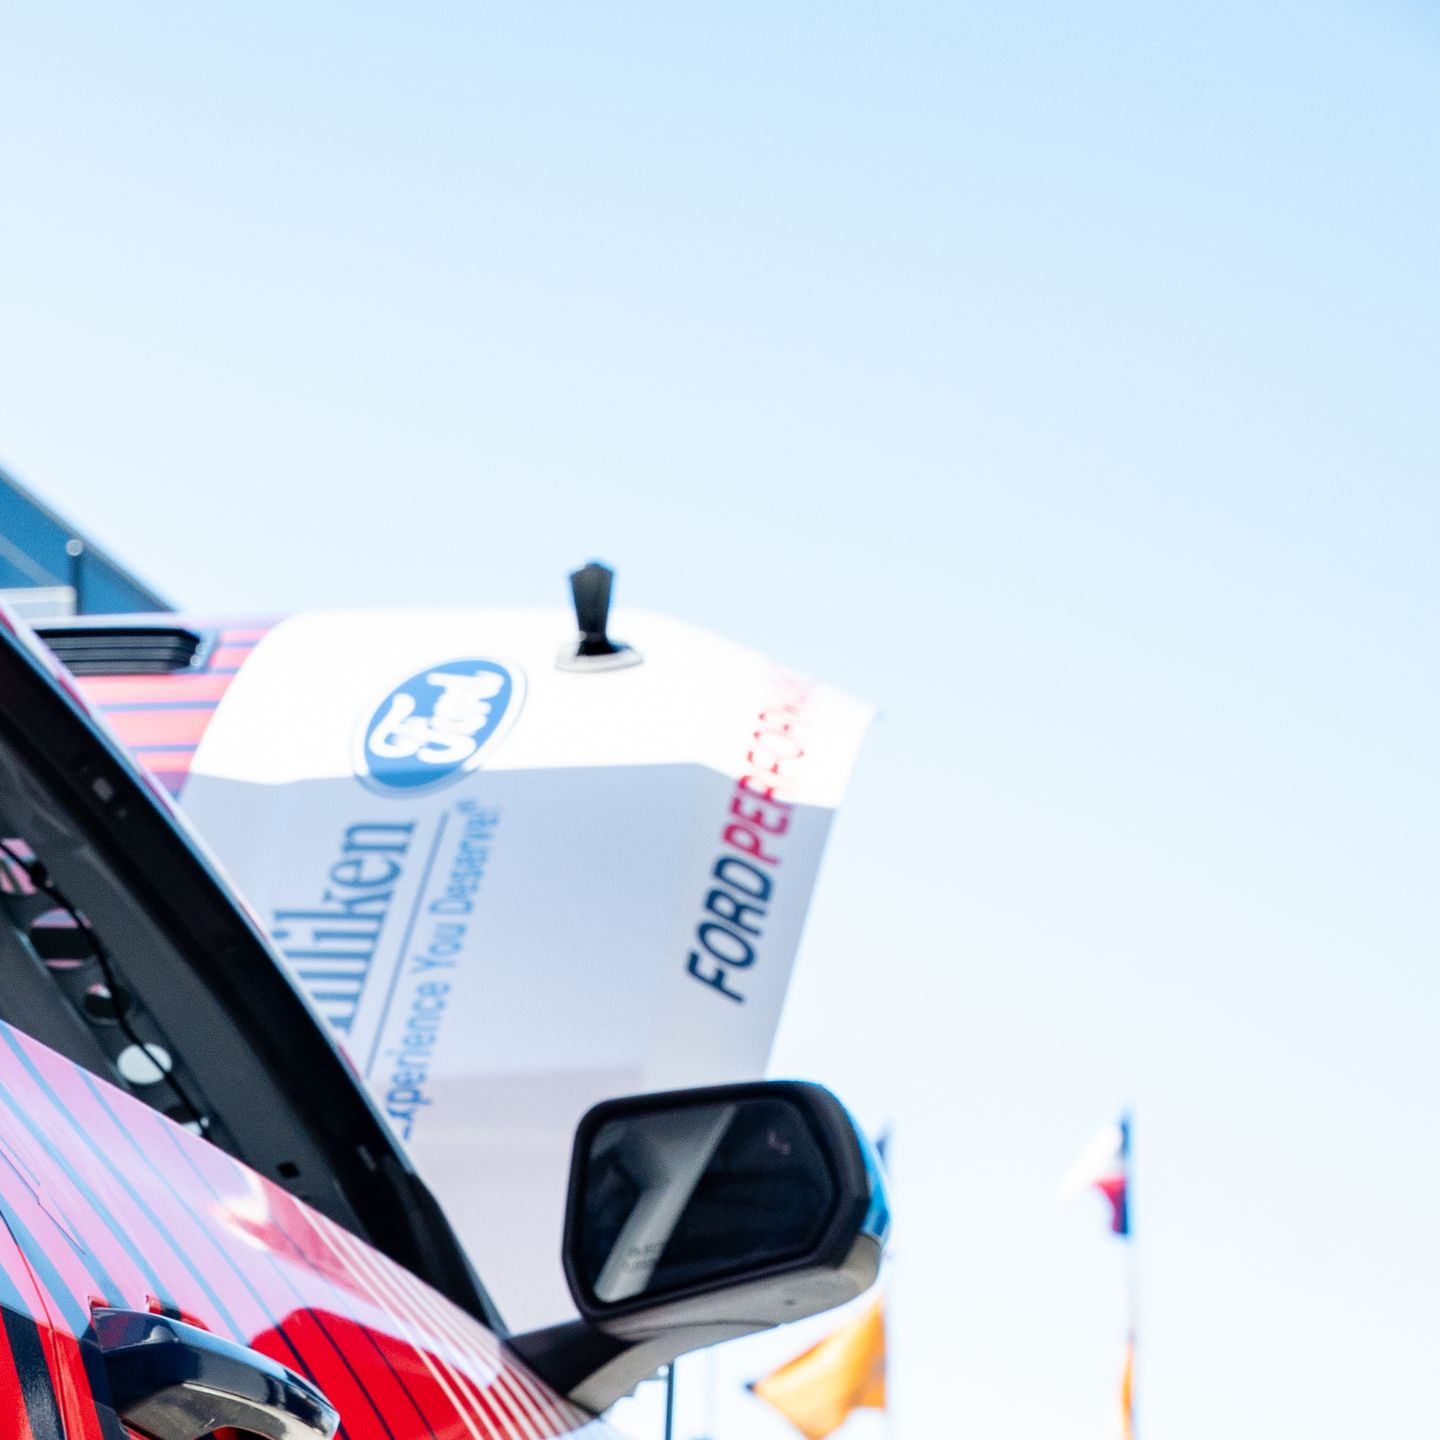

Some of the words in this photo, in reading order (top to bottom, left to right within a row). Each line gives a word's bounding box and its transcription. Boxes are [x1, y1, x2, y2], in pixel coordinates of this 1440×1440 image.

[410, 921, 468, 974] You
[685, 853, 777, 1005] FORD
[385, 978, 450, 1142] xperience
